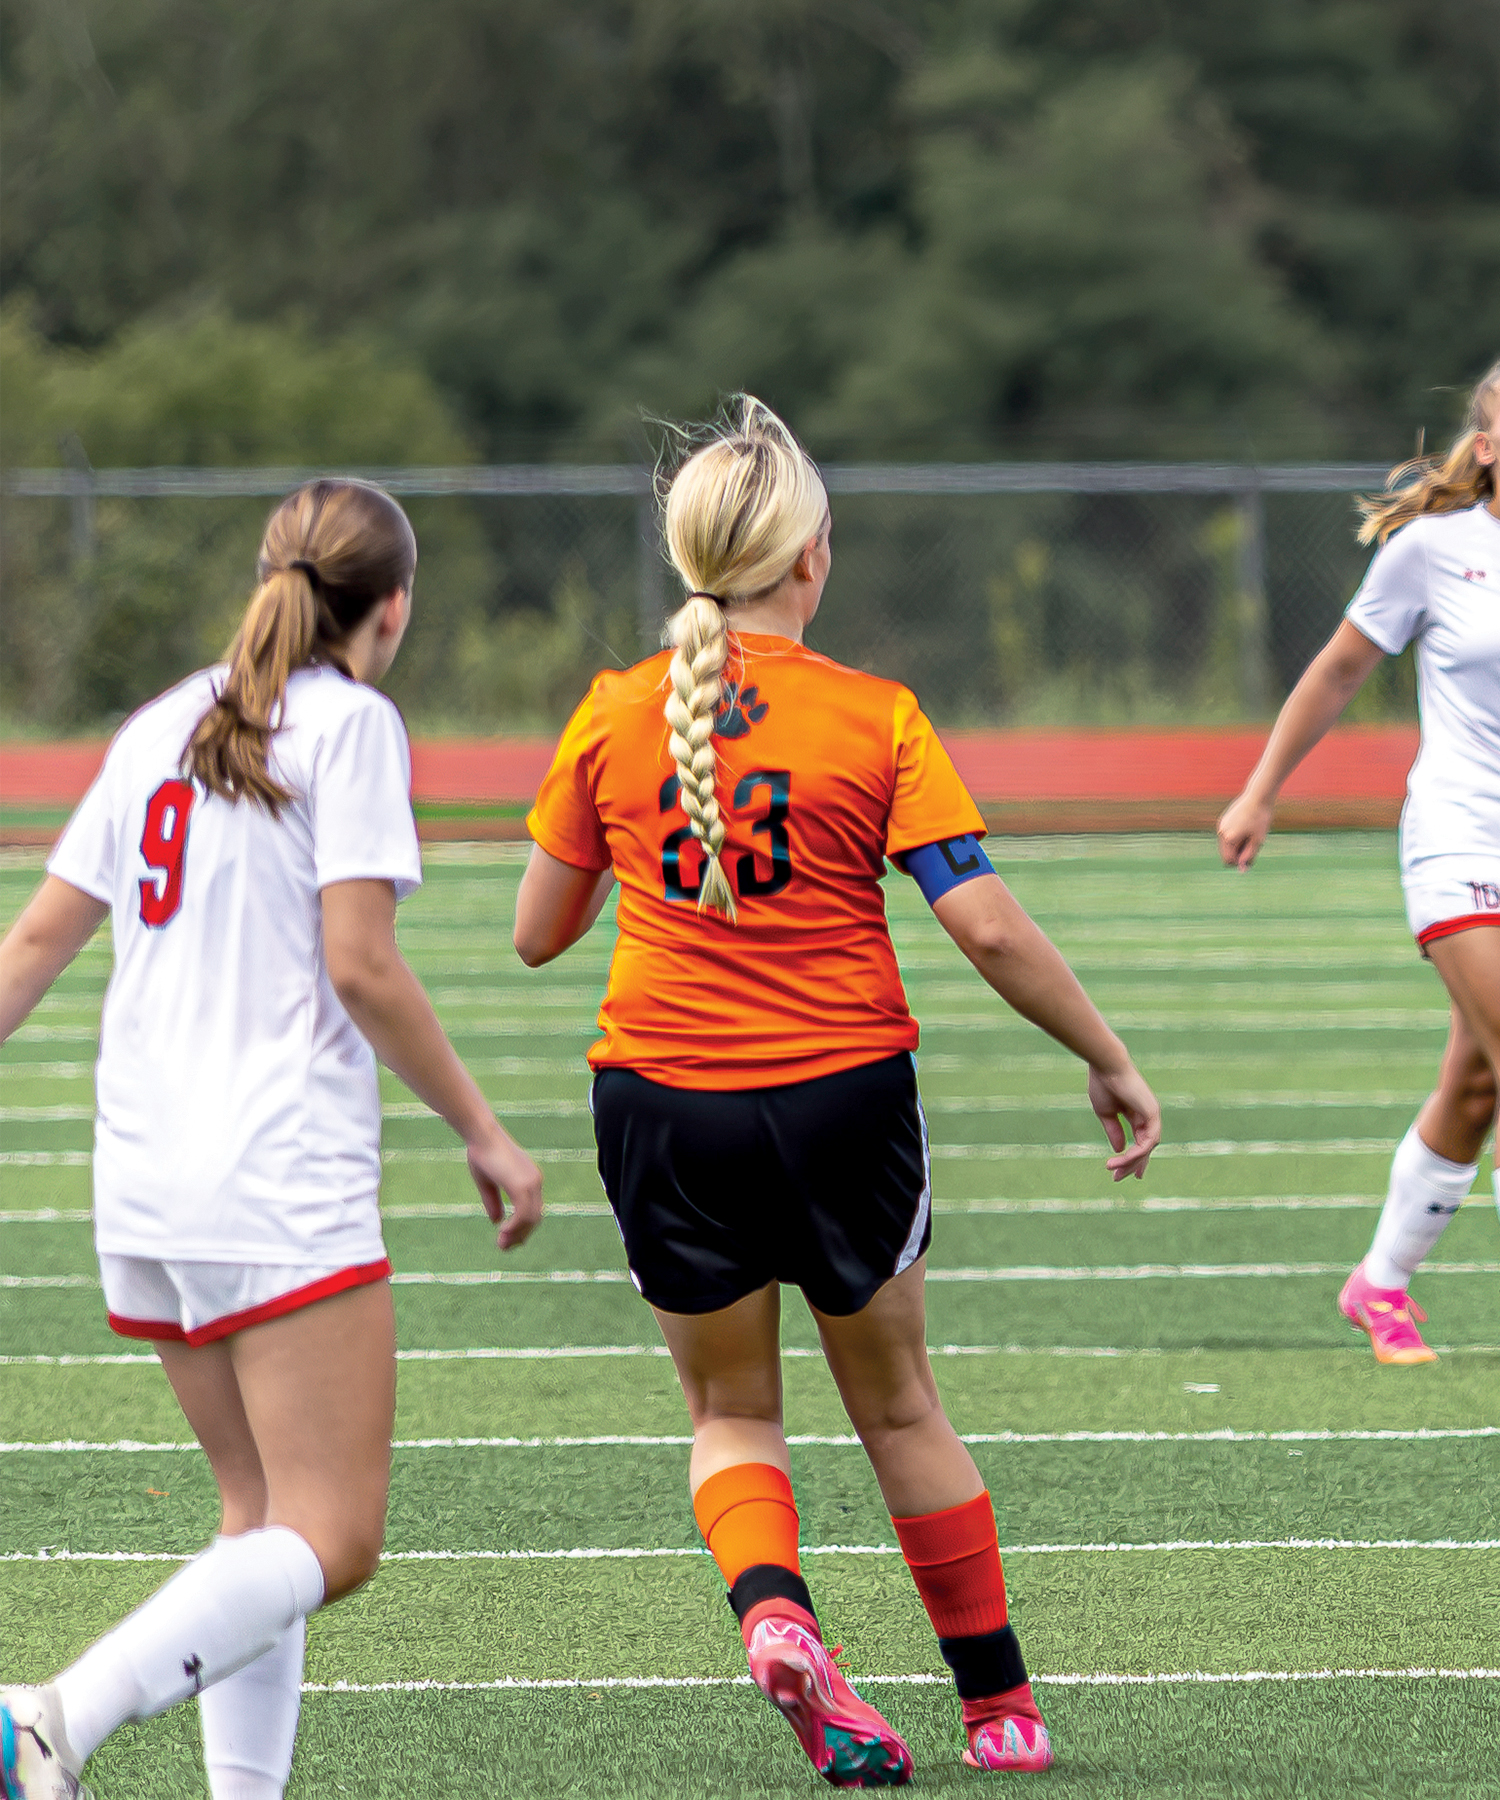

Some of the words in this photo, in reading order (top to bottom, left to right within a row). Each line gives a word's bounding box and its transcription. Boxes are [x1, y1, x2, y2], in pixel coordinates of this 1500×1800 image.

[139, 778, 196, 930] 9
[659, 771, 791, 901] 23
[937, 834, 980, 876] C
